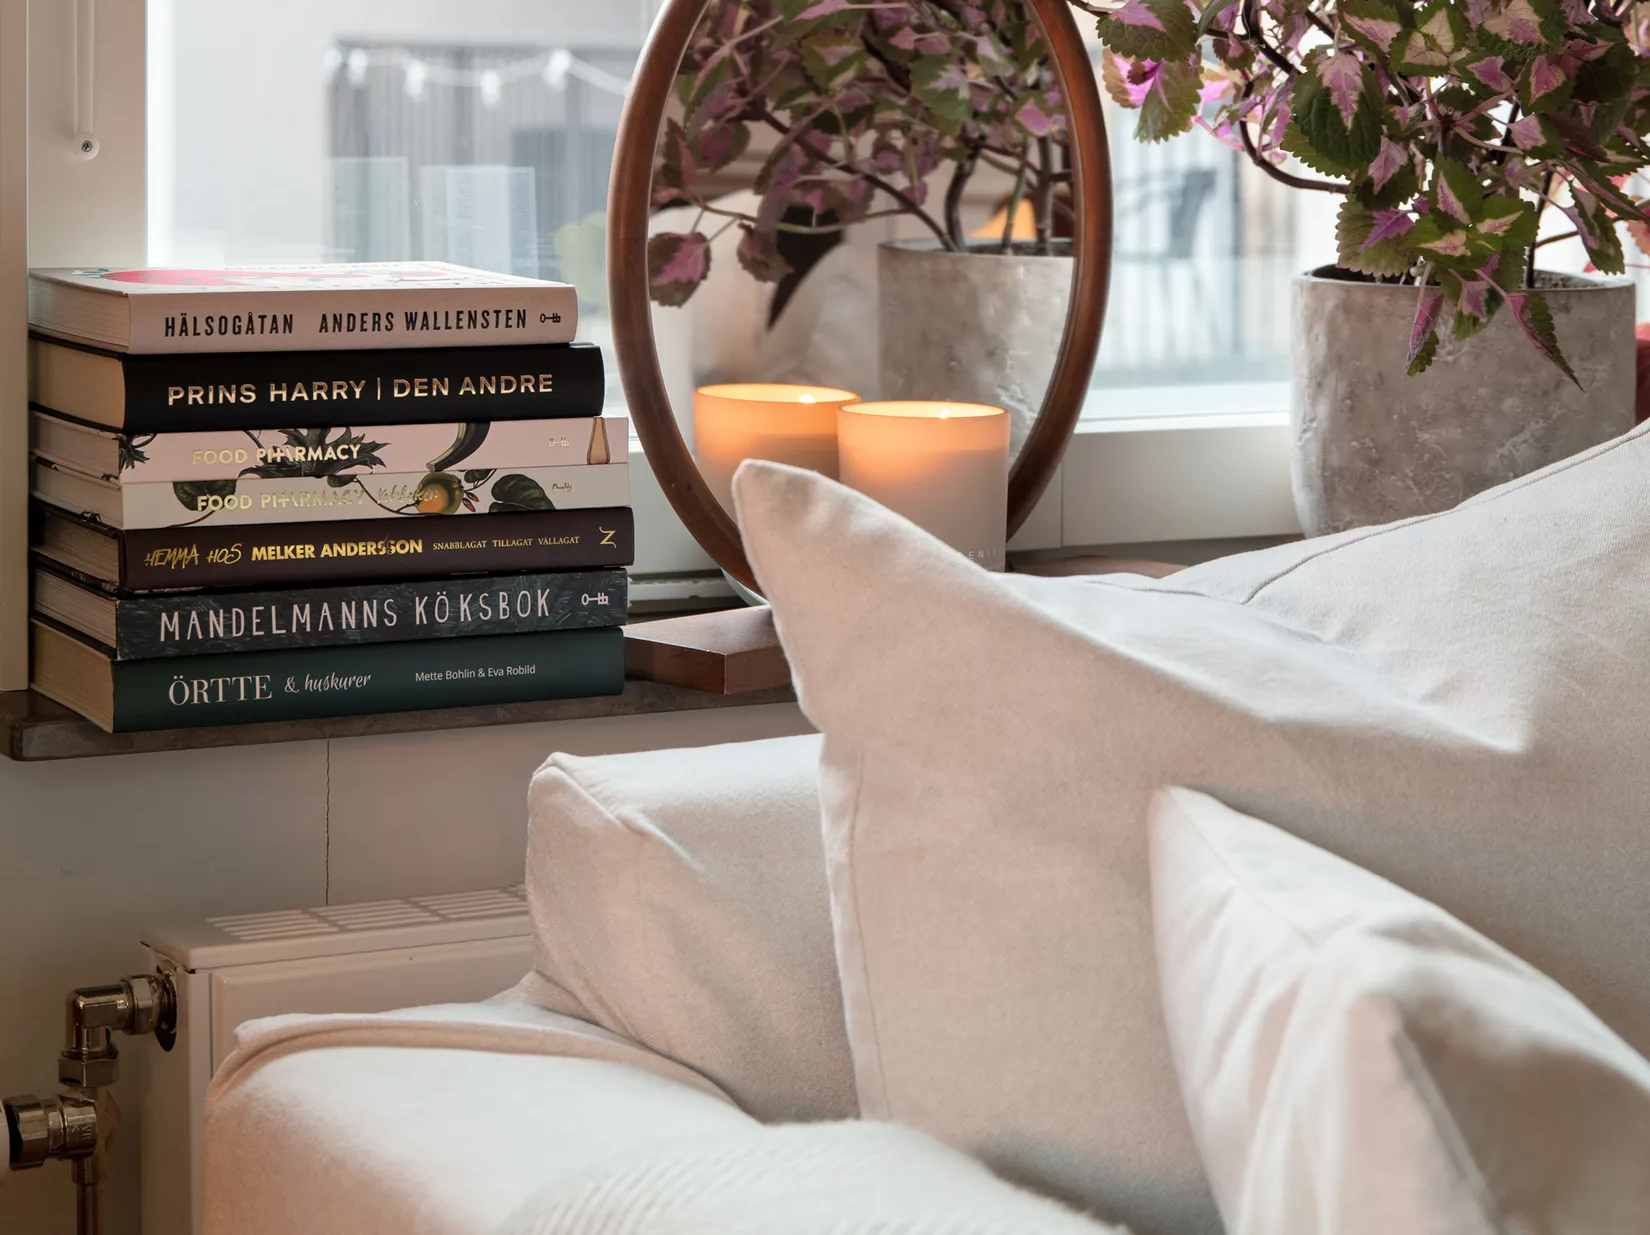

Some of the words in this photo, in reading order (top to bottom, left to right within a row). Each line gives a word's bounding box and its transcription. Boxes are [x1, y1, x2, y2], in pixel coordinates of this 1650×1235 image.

[165, 311, 293, 337] HÄLSOGÅTAN
[319, 312, 394, 333] ANDERS
[404, 309, 527, 331] WALLENSTEN
[168, 383, 257, 406] PRINS
[269, 380, 366, 402] HARRY
[393, 377, 449, 398] DEN
[458, 374, 553, 395] ANDRE
[192, 449, 248, 466] FOOD
[255, 444, 362, 463] PHARMACY
[197, 494, 252, 512] FOOD
[261, 489, 366, 509] PHARMACY
[144, 543, 199, 570] HEMMA
[206, 543, 243, 564] HOS
[251, 544, 316, 561] MELKER
[320, 539, 423, 558] ANDERSSON
[432, 540, 487, 550] SNABBLAGAT
[492, 538, 533, 548] TILLAGAT
[160, 598, 397, 642] MANDELMANNS
[415, 588, 550, 625] KÖKSBOK
[415, 671, 443, 682] Mette
[445, 668, 475, 680] Bohlin
[478, 668, 486, 678] &
[488, 667, 504, 677] Eva
[506, 664, 536, 675] Robild
[168, 674, 273, 706] ÖRTTE
[284, 676, 300, 693] &
[304, 672, 372, 693] huskurer
